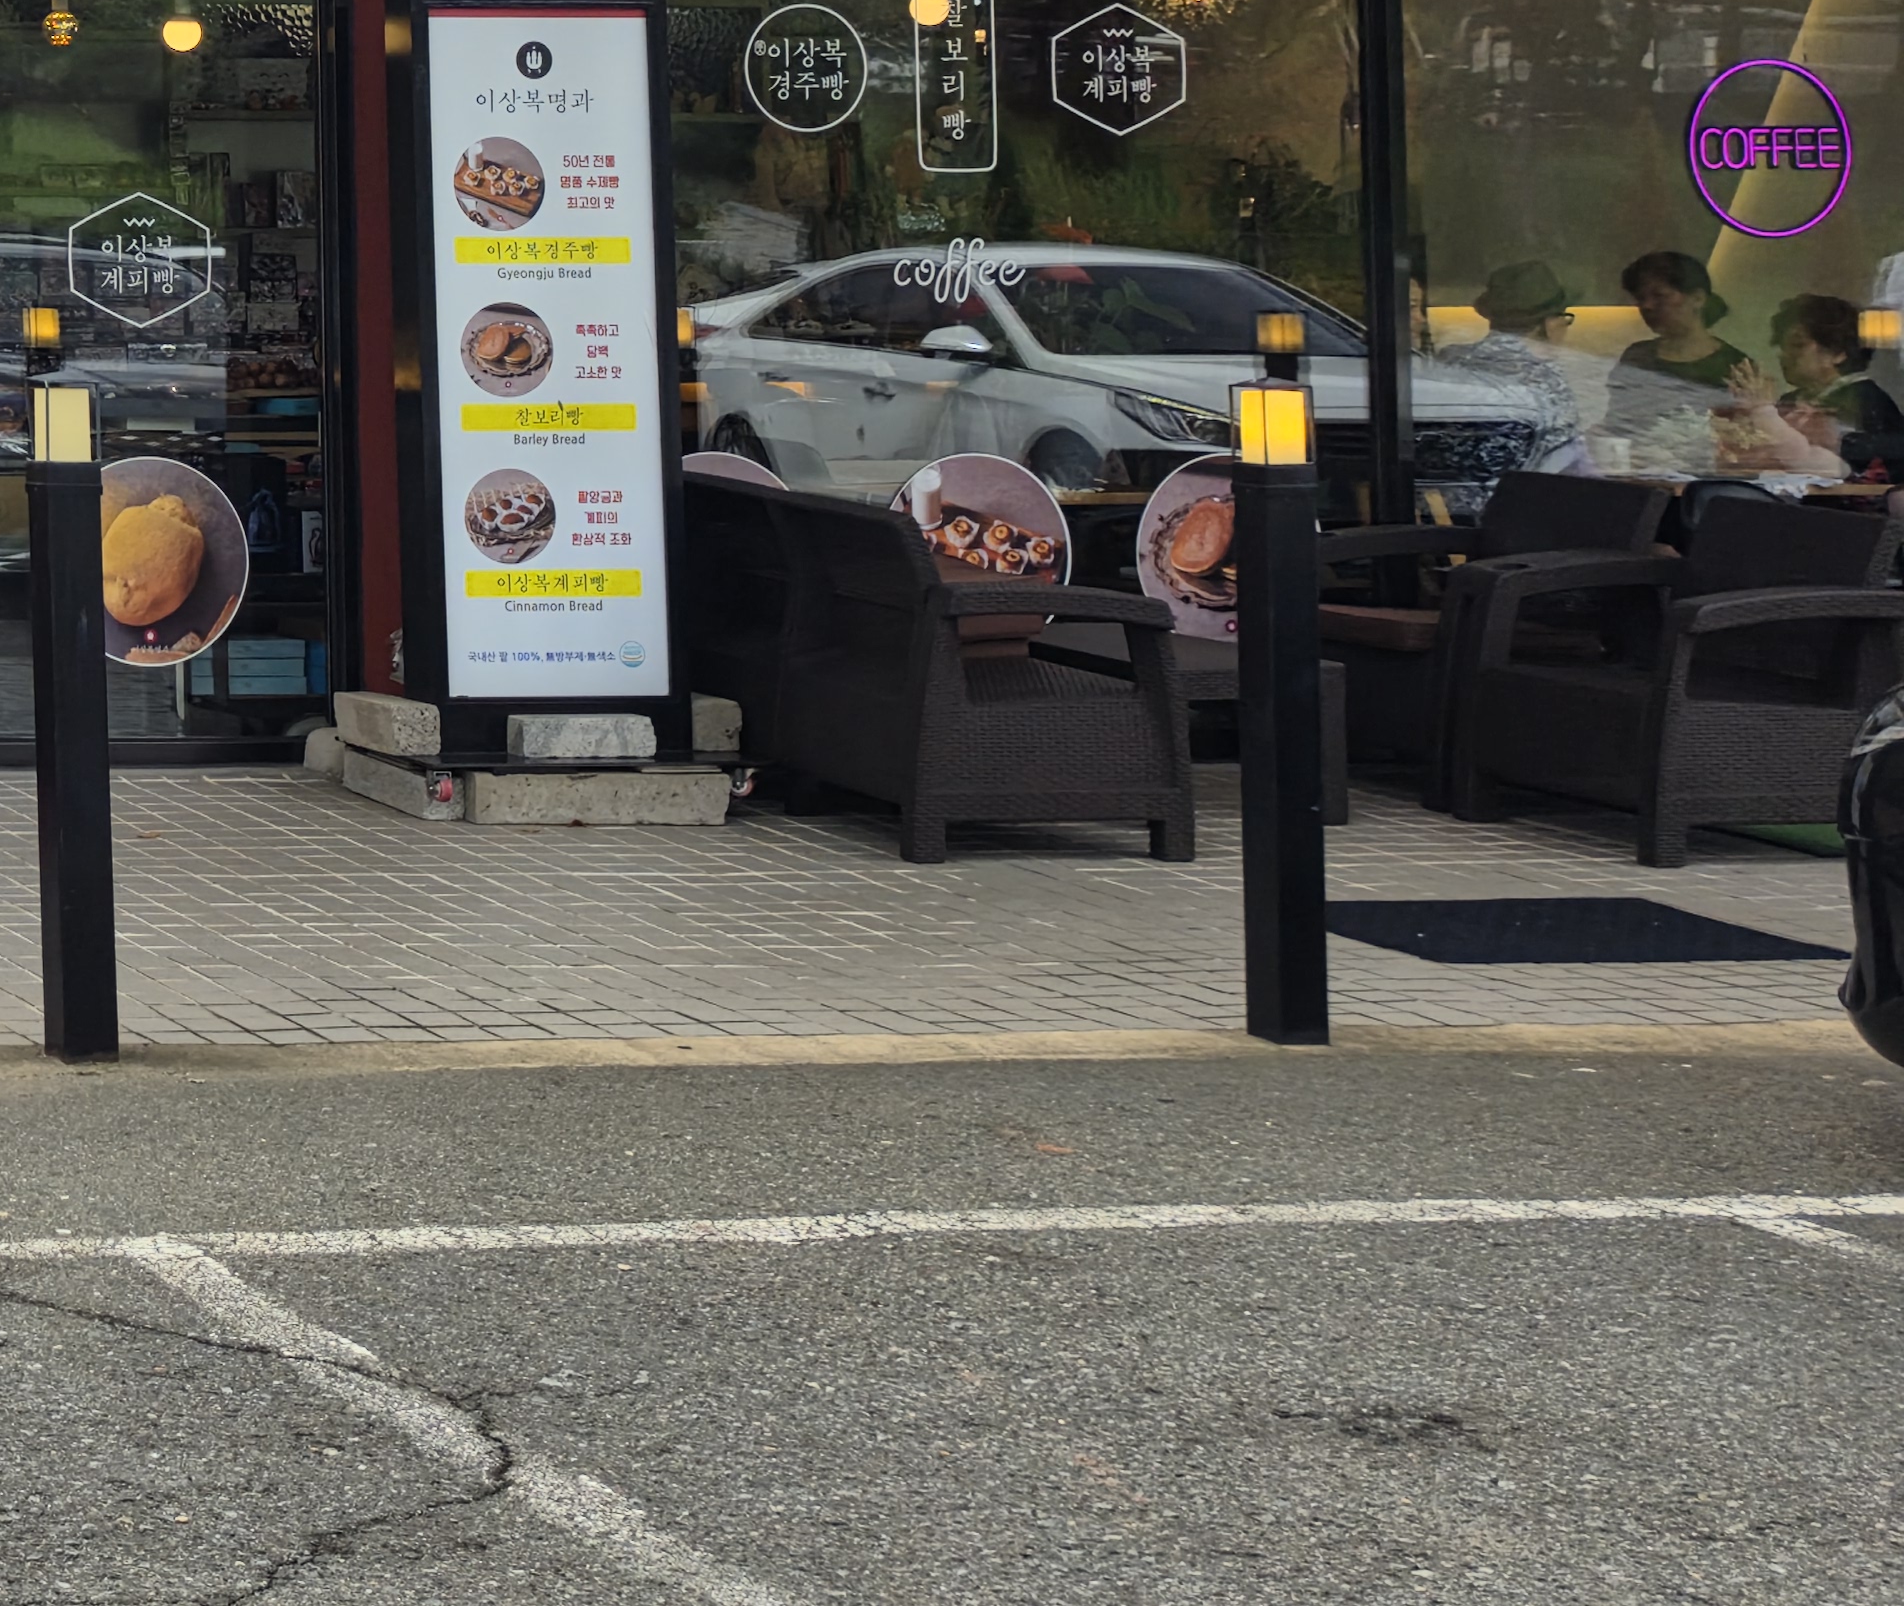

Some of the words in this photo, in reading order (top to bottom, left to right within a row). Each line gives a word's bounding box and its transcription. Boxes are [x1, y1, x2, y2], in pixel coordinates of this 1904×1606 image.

[768, 37, 847, 68] 이상복
[1082, 44, 1155, 73] 이상복
[768, 71, 849, 100] 경주빵
[1083, 75, 1157, 103] 계피빵
[476, 88, 594, 113] 이상복명과
[1699, 127, 1841, 169] COFFEE
[563, 154, 590, 168] 50년
[567, 196, 600, 209] 최고의
[603, 196, 615, 209] 맛
[101, 235, 174, 263] 이상복
[487, 241, 598, 260] 이상복경주빵
[101, 265, 181, 294] 계피빵
[497, 267, 555, 281] Gyeongju
[558, 267, 592, 279] Bread
[893, 237, 1026, 303] coffee
[574, 366, 607, 379] 고소한
[611, 365, 622, 379] 맛
[515, 405, 583, 426] 찰보리빵
[513, 433, 548, 447] Barley
[552, 433, 585, 445] Bread
[497, 573, 609, 593] 이상복계피빵
[504, 600, 565, 611] Cinnamon
[569, 600, 603, 611] Bread
